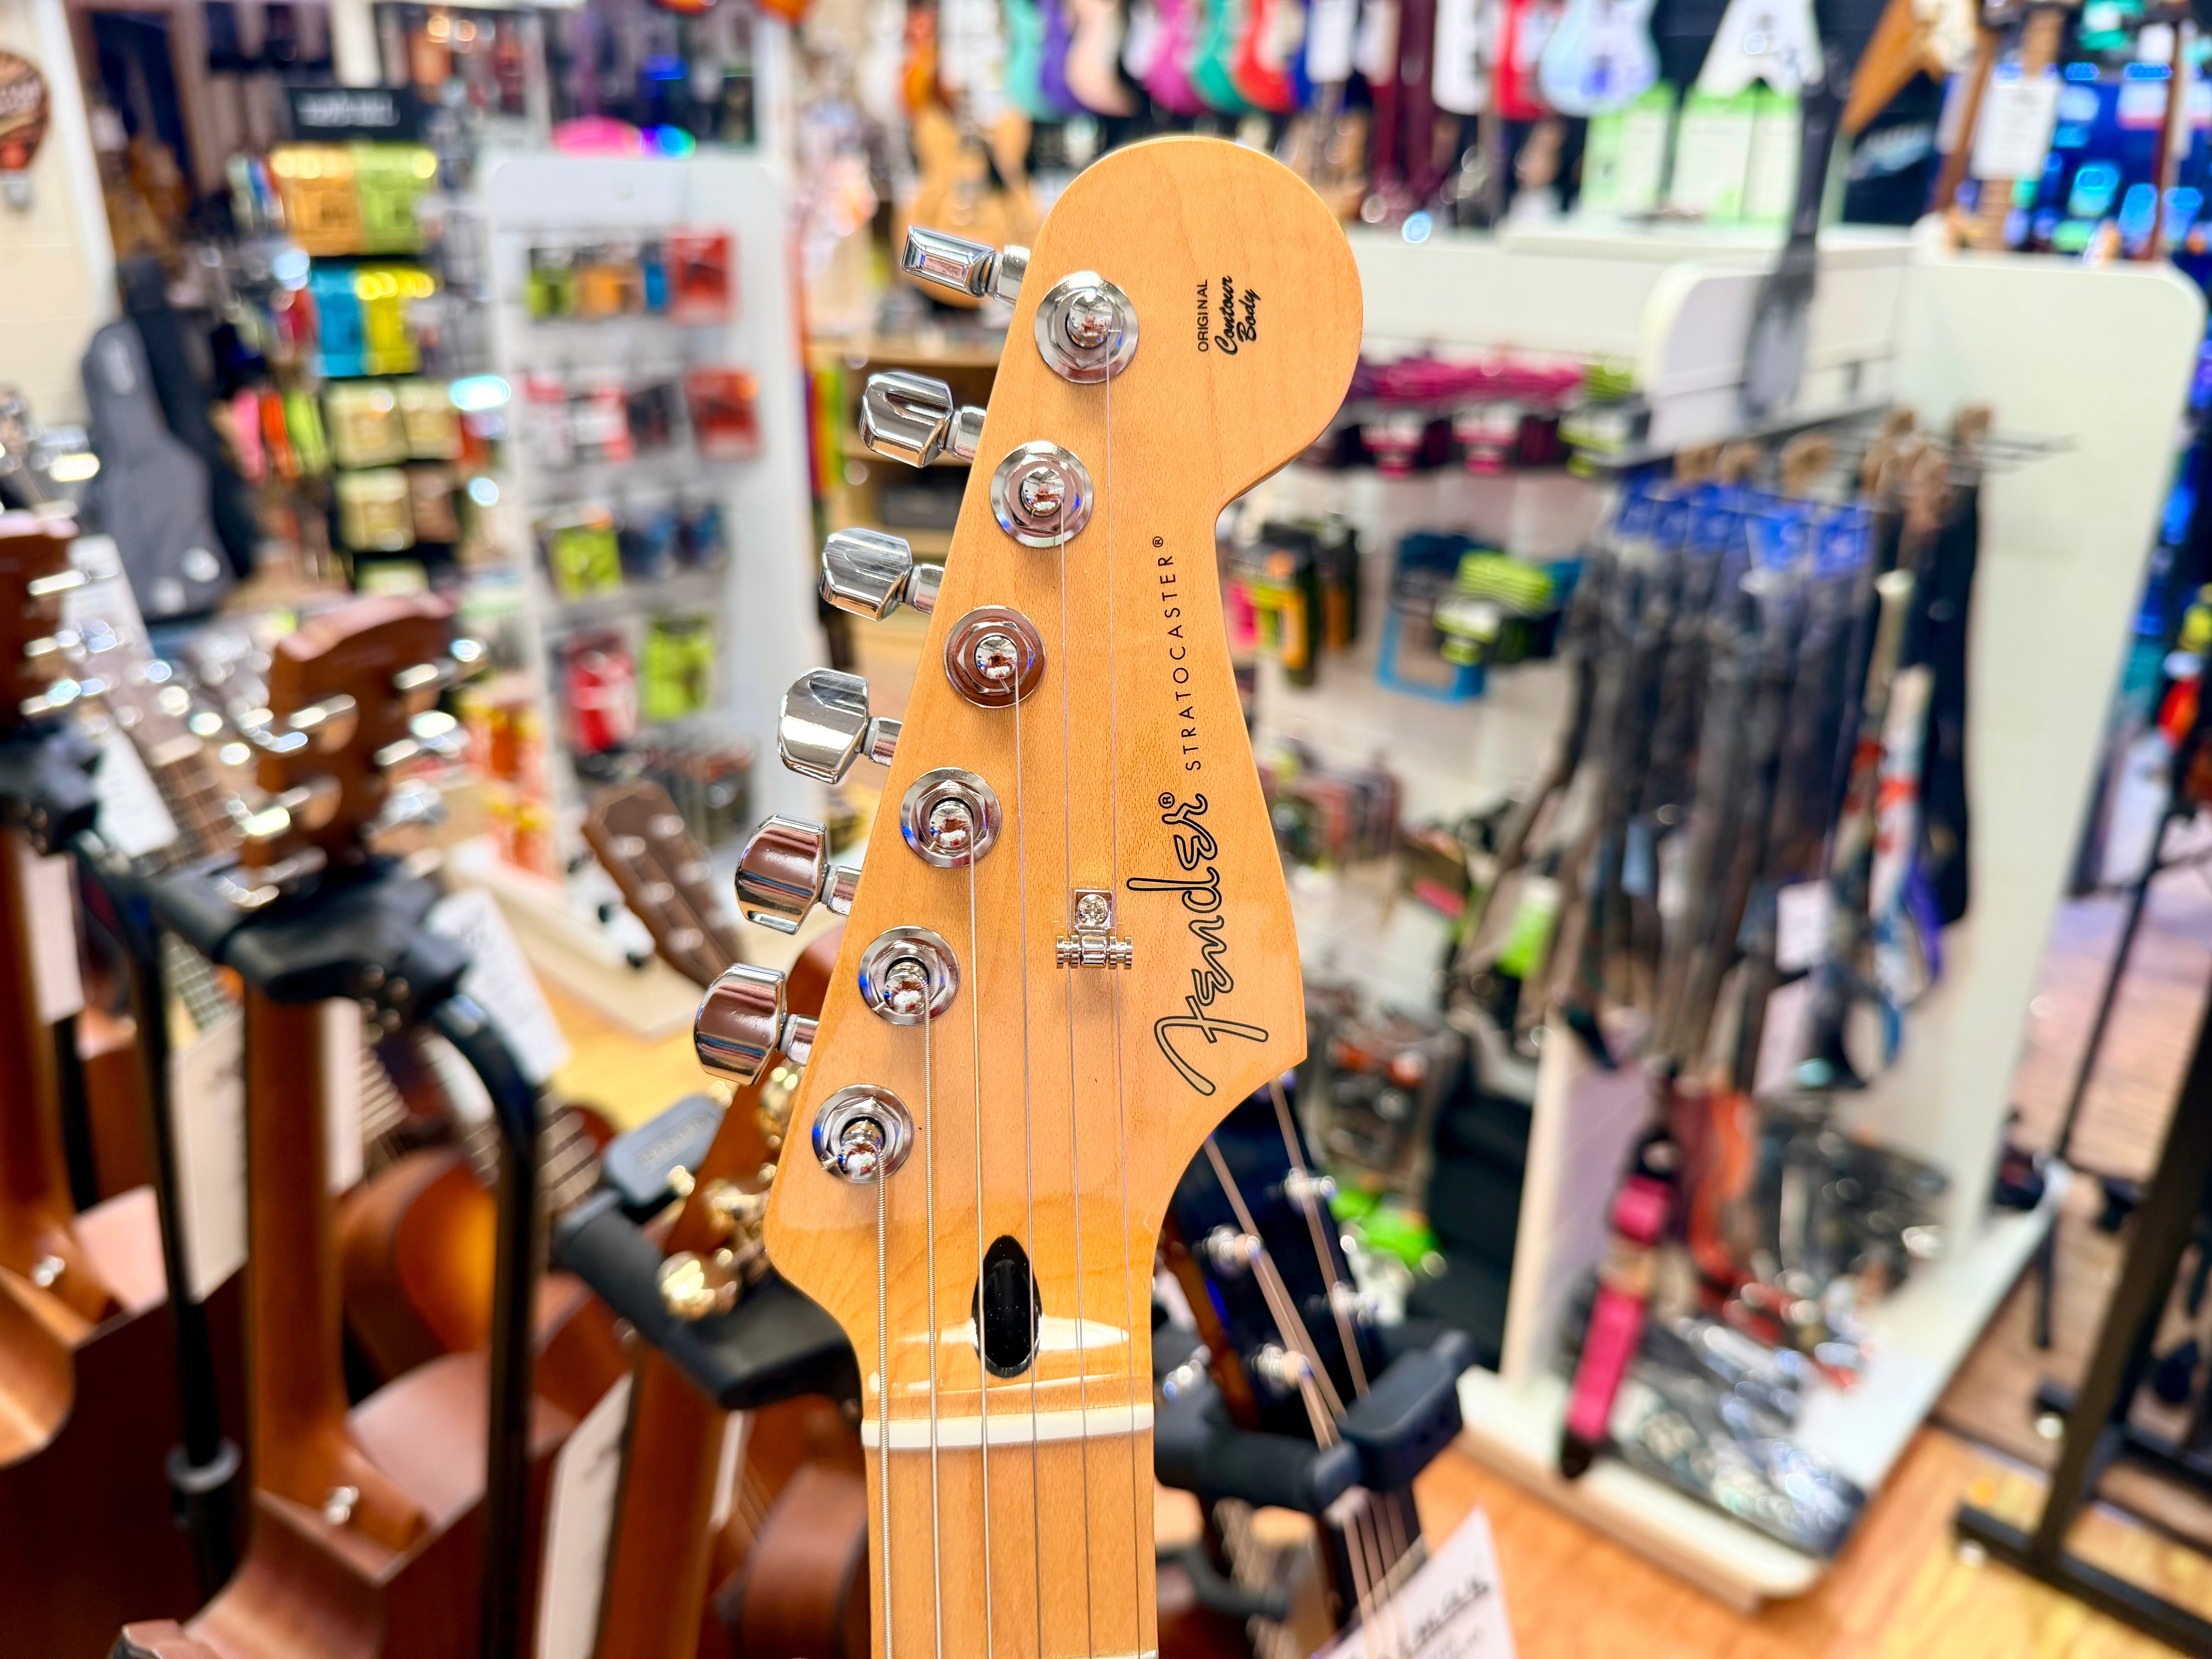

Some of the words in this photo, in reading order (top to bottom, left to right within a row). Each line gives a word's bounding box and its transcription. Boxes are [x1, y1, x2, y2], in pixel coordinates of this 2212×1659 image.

[1197, 279, 1209, 352] ORIGINAL
[1214, 276, 1238, 355] Contour
[1237, 289, 1261, 342] Body
